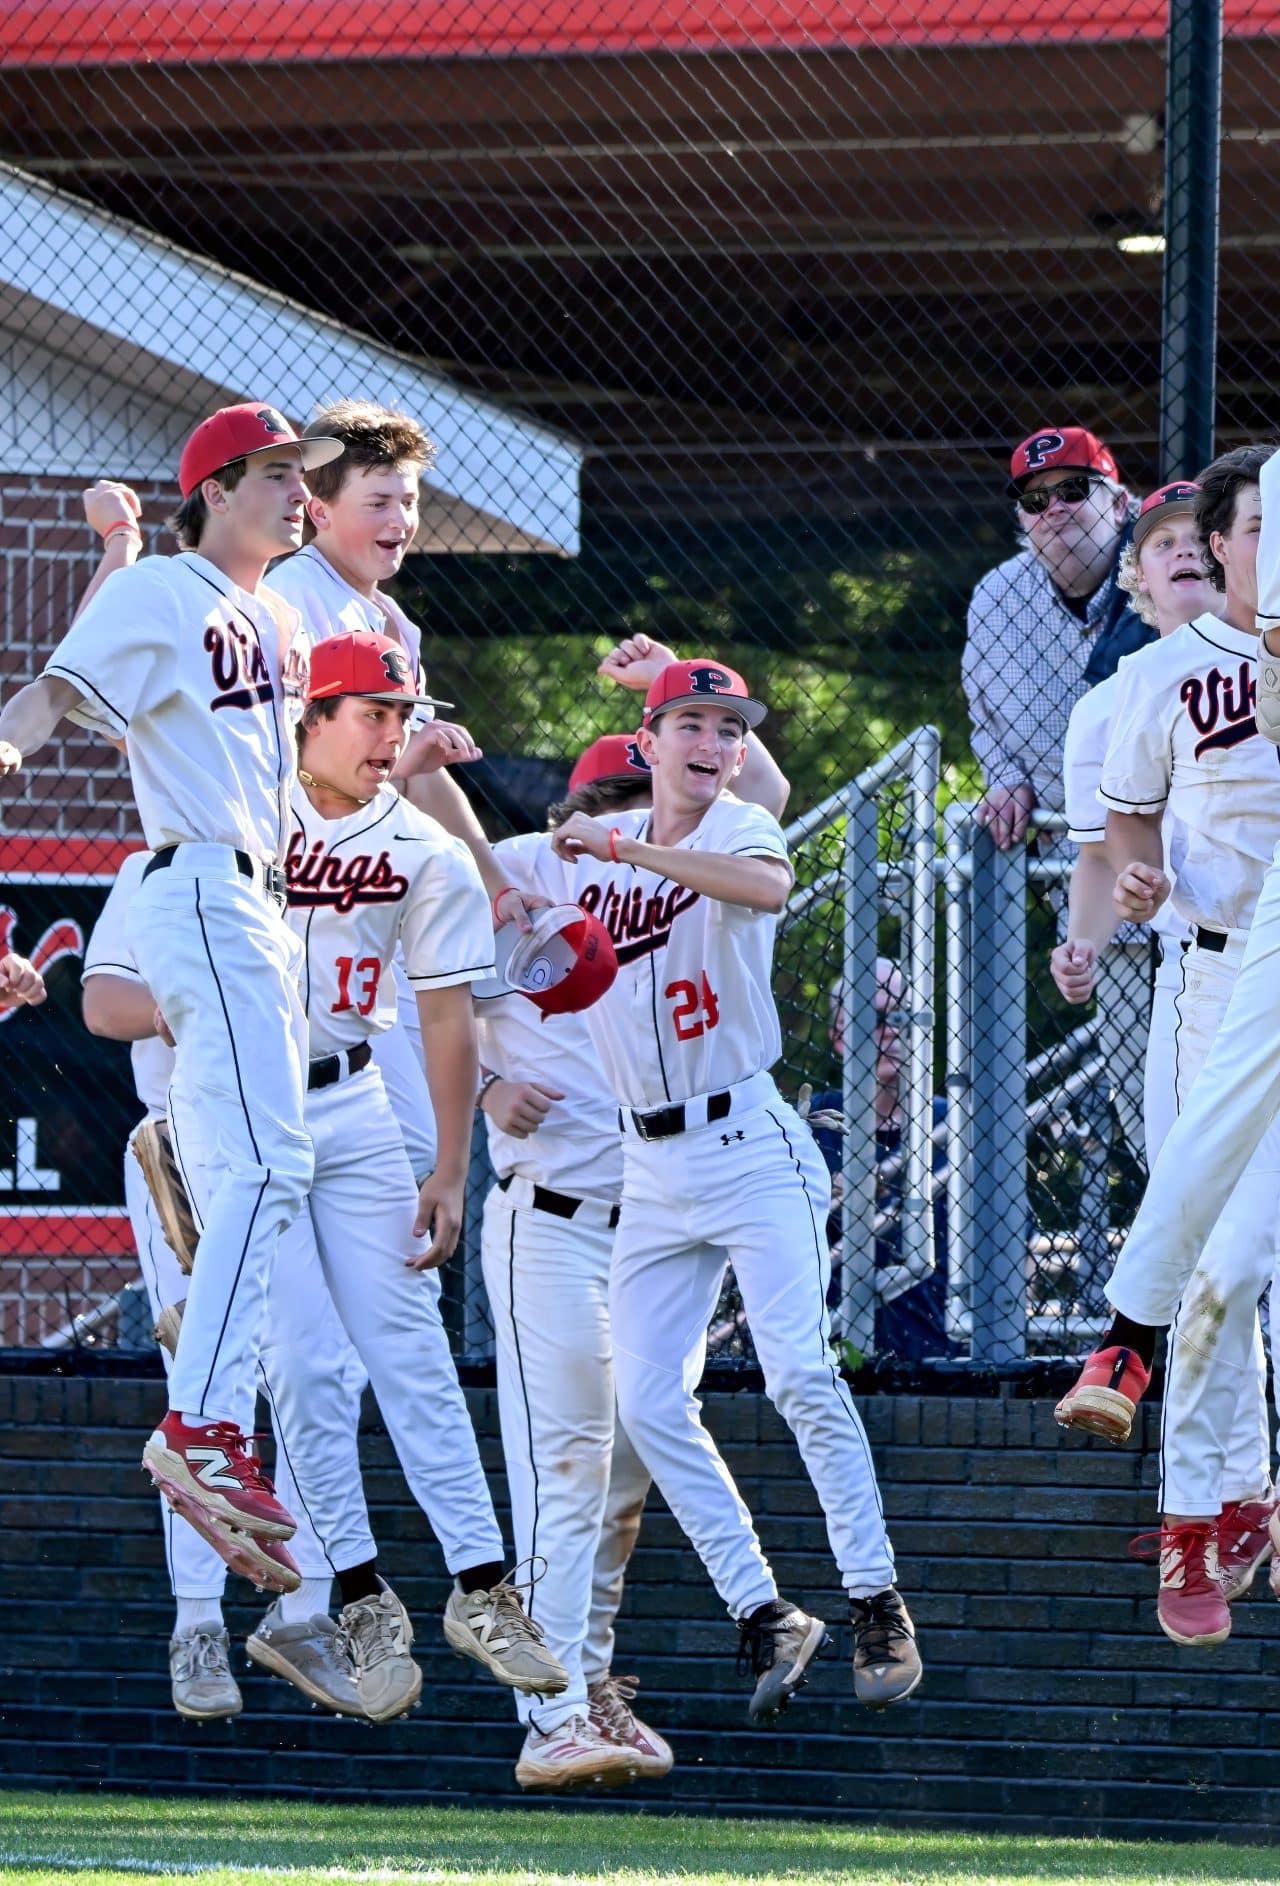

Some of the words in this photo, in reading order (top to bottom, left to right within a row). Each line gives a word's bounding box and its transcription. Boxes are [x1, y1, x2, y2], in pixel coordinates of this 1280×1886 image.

[1024, 433, 1065, 468] P
[688, 667, 734, 694] P
[284, 831, 409, 915] kings
[330, 956, 382, 1017] 13
[664, 969, 720, 1042] 24
[185, 1445, 245, 1491] N
